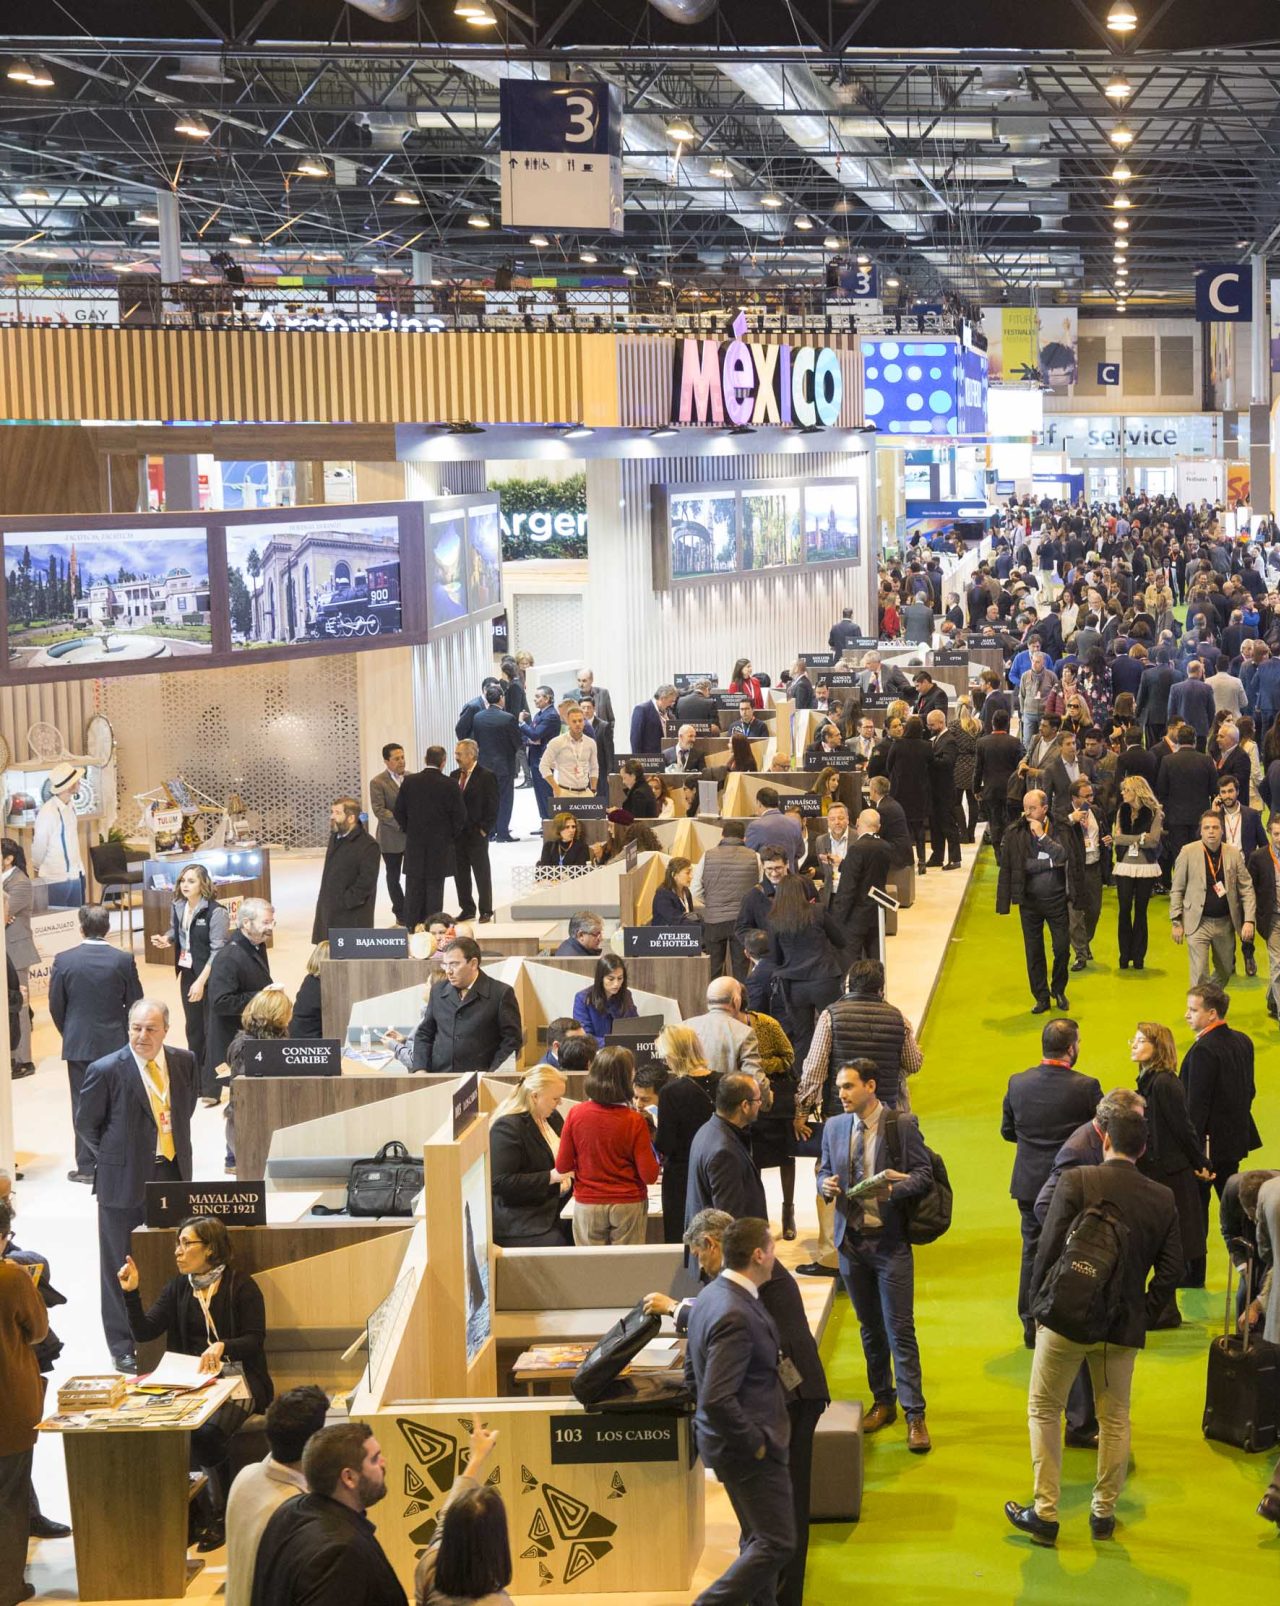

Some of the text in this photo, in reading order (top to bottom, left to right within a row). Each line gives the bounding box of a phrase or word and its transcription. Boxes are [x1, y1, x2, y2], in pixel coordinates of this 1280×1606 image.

[565, 96, 594, 143] 3
[854, 271, 871, 294] 3
[1209, 273, 1239, 314] C
[75, 309, 108, 321] GAY
[1102, 366, 1115, 383] C
[370, 588, 388, 601] 900
[337, 937, 406, 947] 8 BAJA NORTE
[631, 935, 638, 945] 7
[649, 940, 699, 948] DE HOTELES
[254, 1047, 332, 1062] 4 CONNEX
[285, 1055, 329, 1064] CARIBE
[160, 1193, 259, 1209] 1 MAYALAND
[192, 1204, 256, 1214] SINCE 1921
[555, 1428, 671, 1443] 103 LOS CABOS
